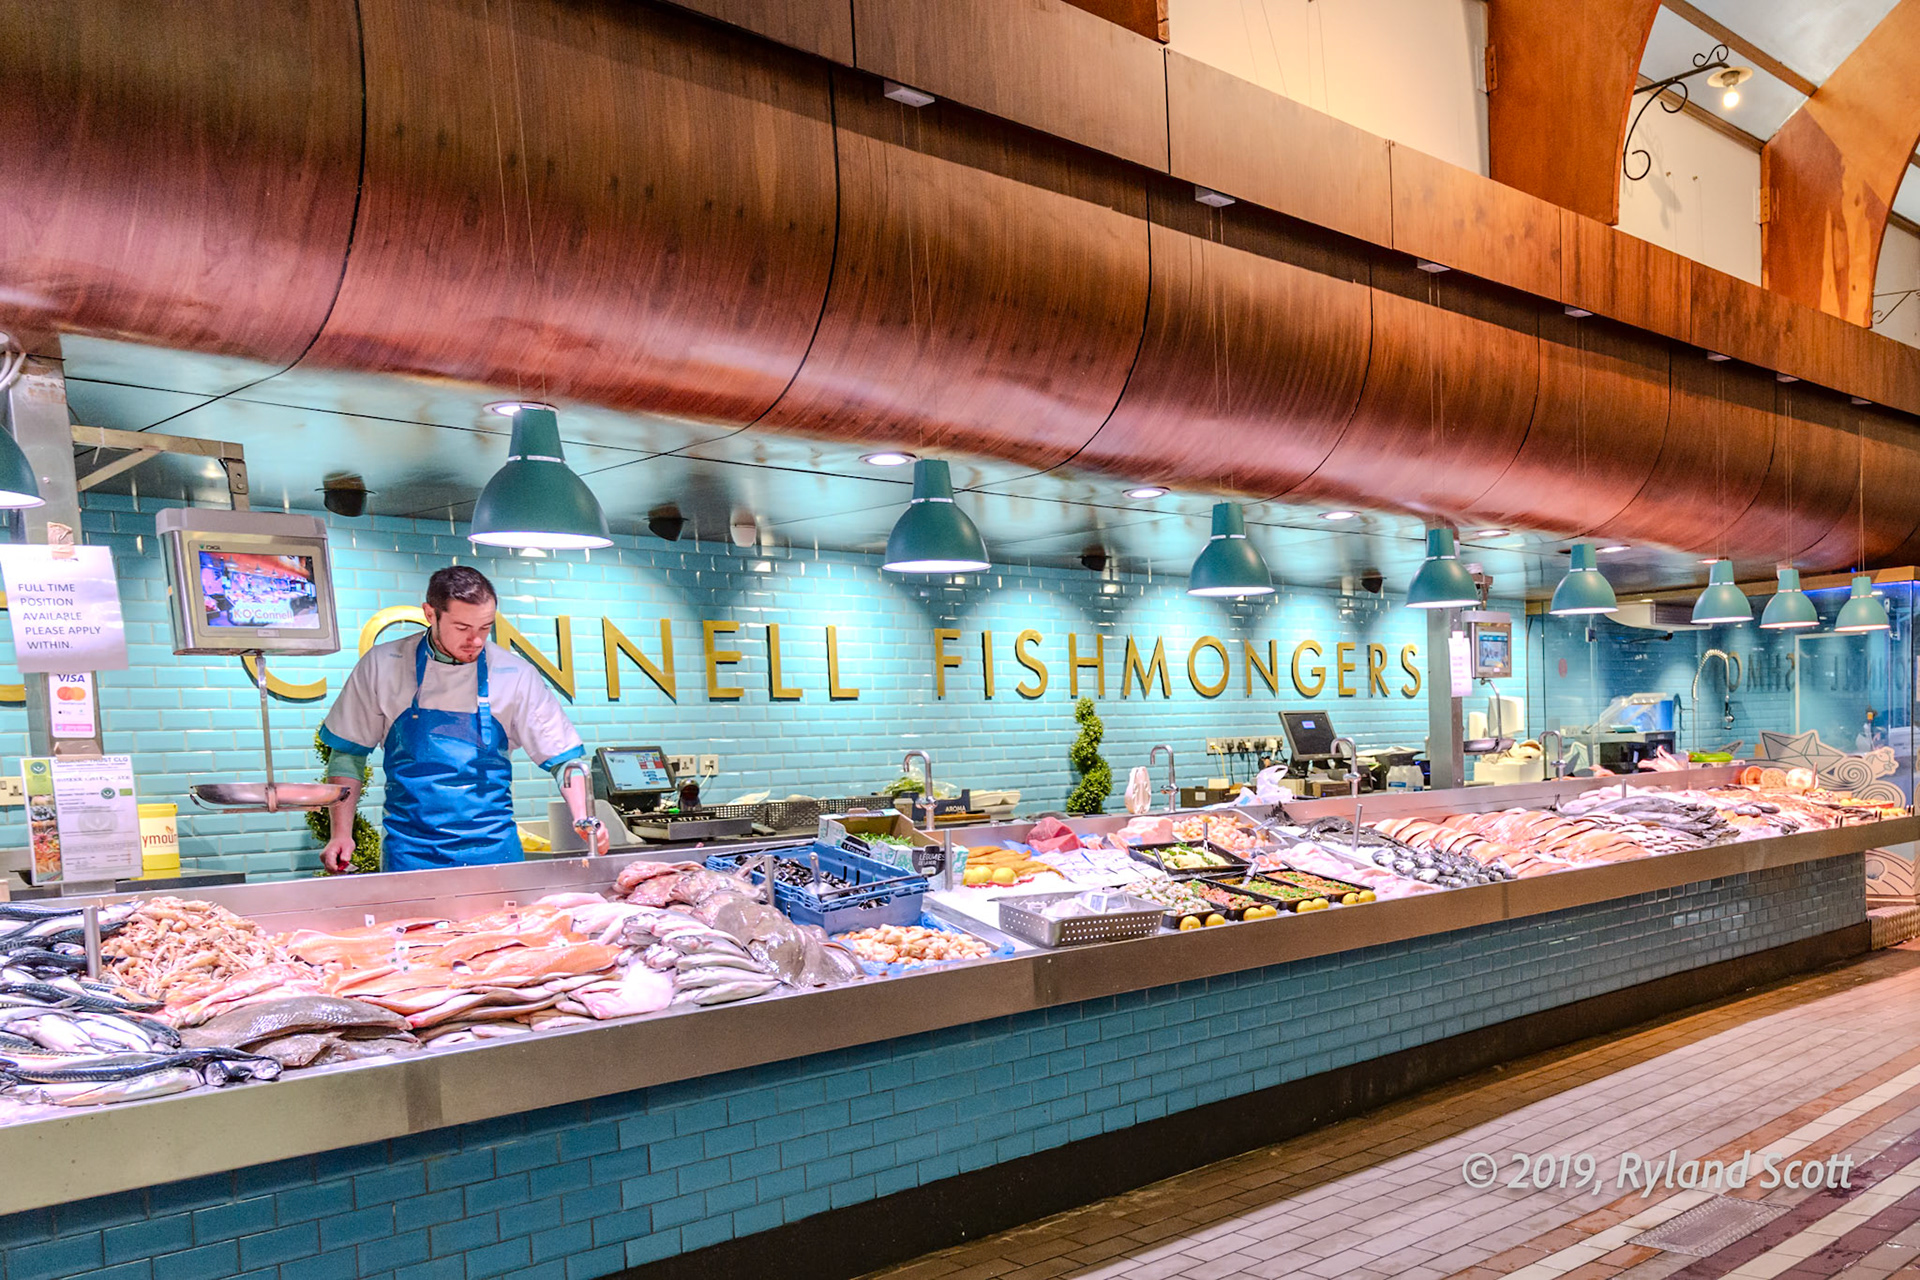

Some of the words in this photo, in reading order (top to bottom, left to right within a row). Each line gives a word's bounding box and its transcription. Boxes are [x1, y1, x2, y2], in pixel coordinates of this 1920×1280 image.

[18, 583, 45, 592] FULL
[47, 583, 75, 592] TIME
[20, 597, 73, 606] POSITION
[23, 612, 82, 620] AVAILABLE
[25, 626, 65, 635] PLEASE
[68, 626, 101, 635] APPLY
[27, 640, 73, 649] WITHIN.
[934, 627, 1422, 699] FISHMONGERS
[57, 673, 85, 682] VISA
